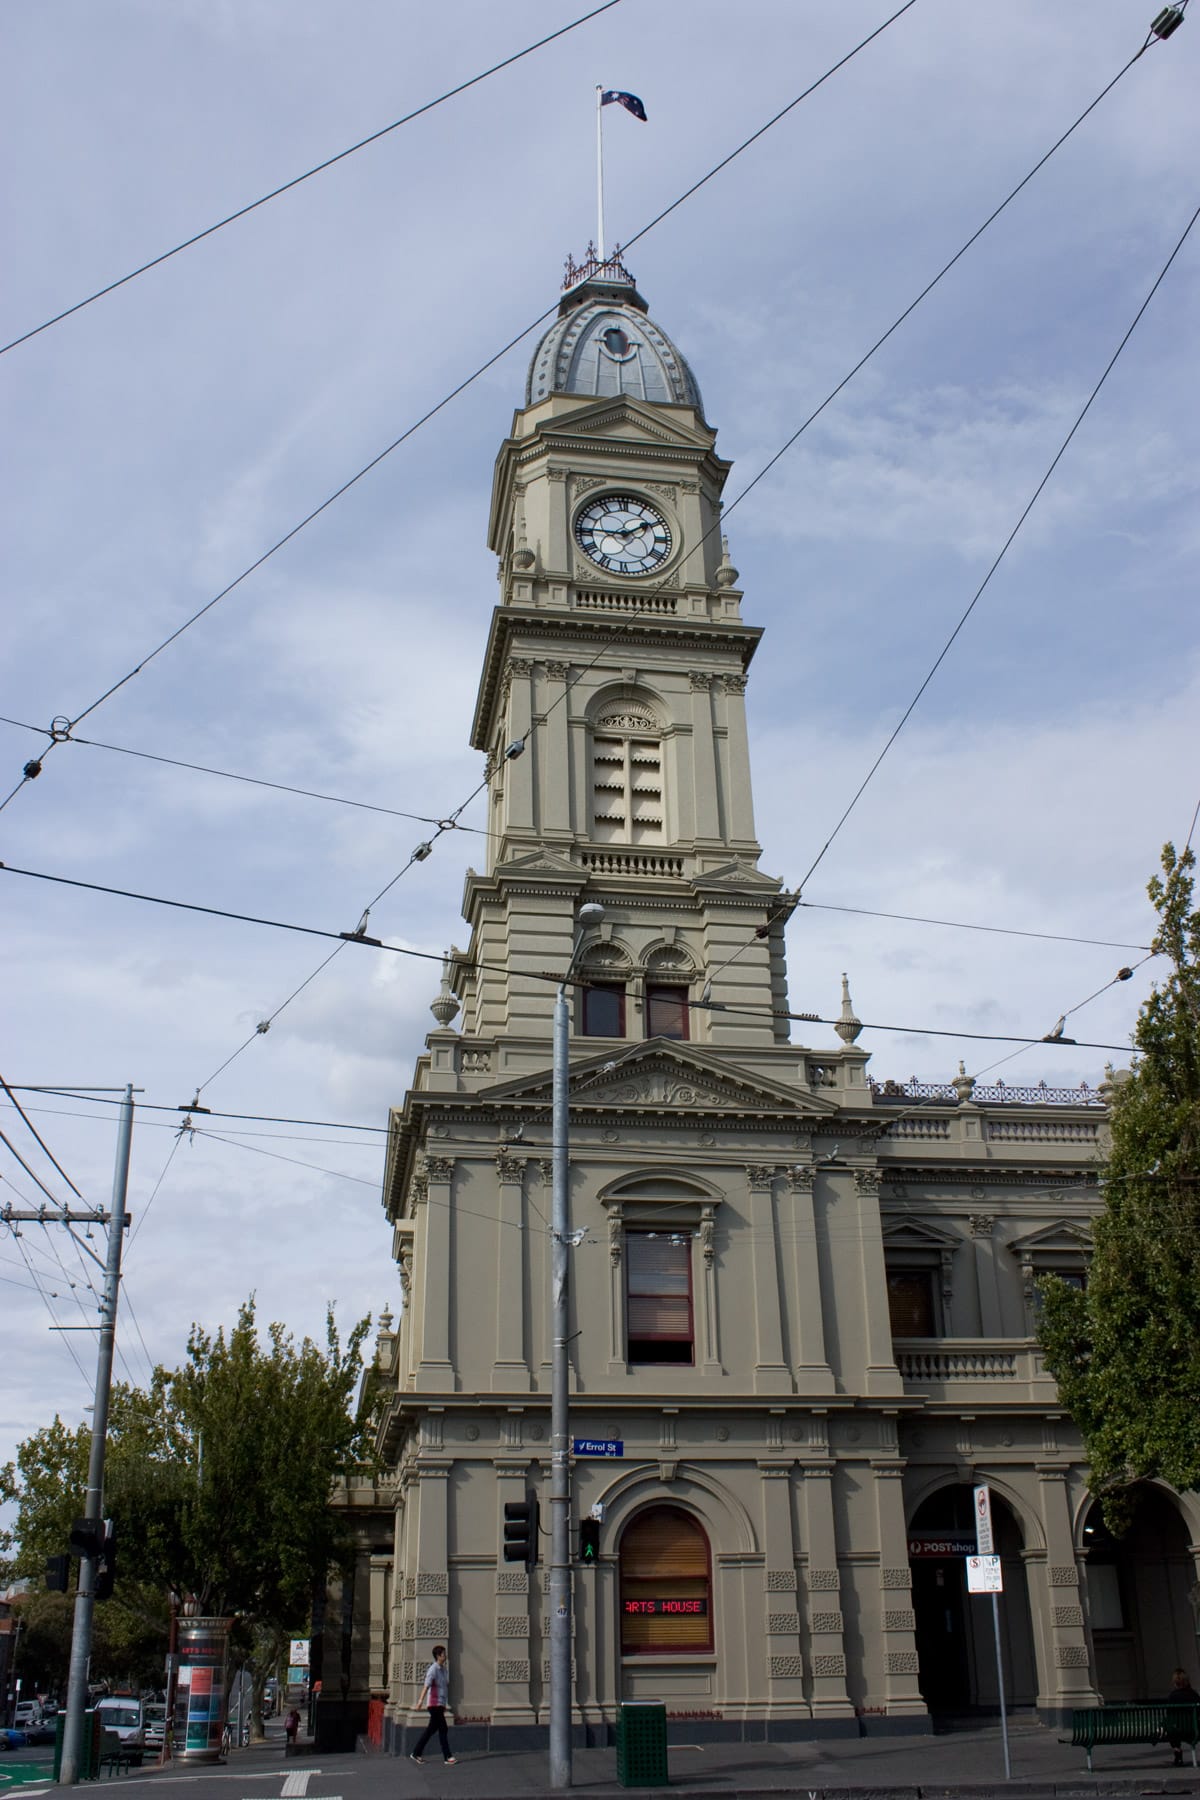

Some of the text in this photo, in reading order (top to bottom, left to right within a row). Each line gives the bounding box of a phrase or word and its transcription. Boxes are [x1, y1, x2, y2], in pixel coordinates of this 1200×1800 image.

[586, 1442, 617, 1452] Errol St
[923, 1542, 976, 1554] POSTshop
[625, 1601, 701, 1613] ARTS HOUSE
